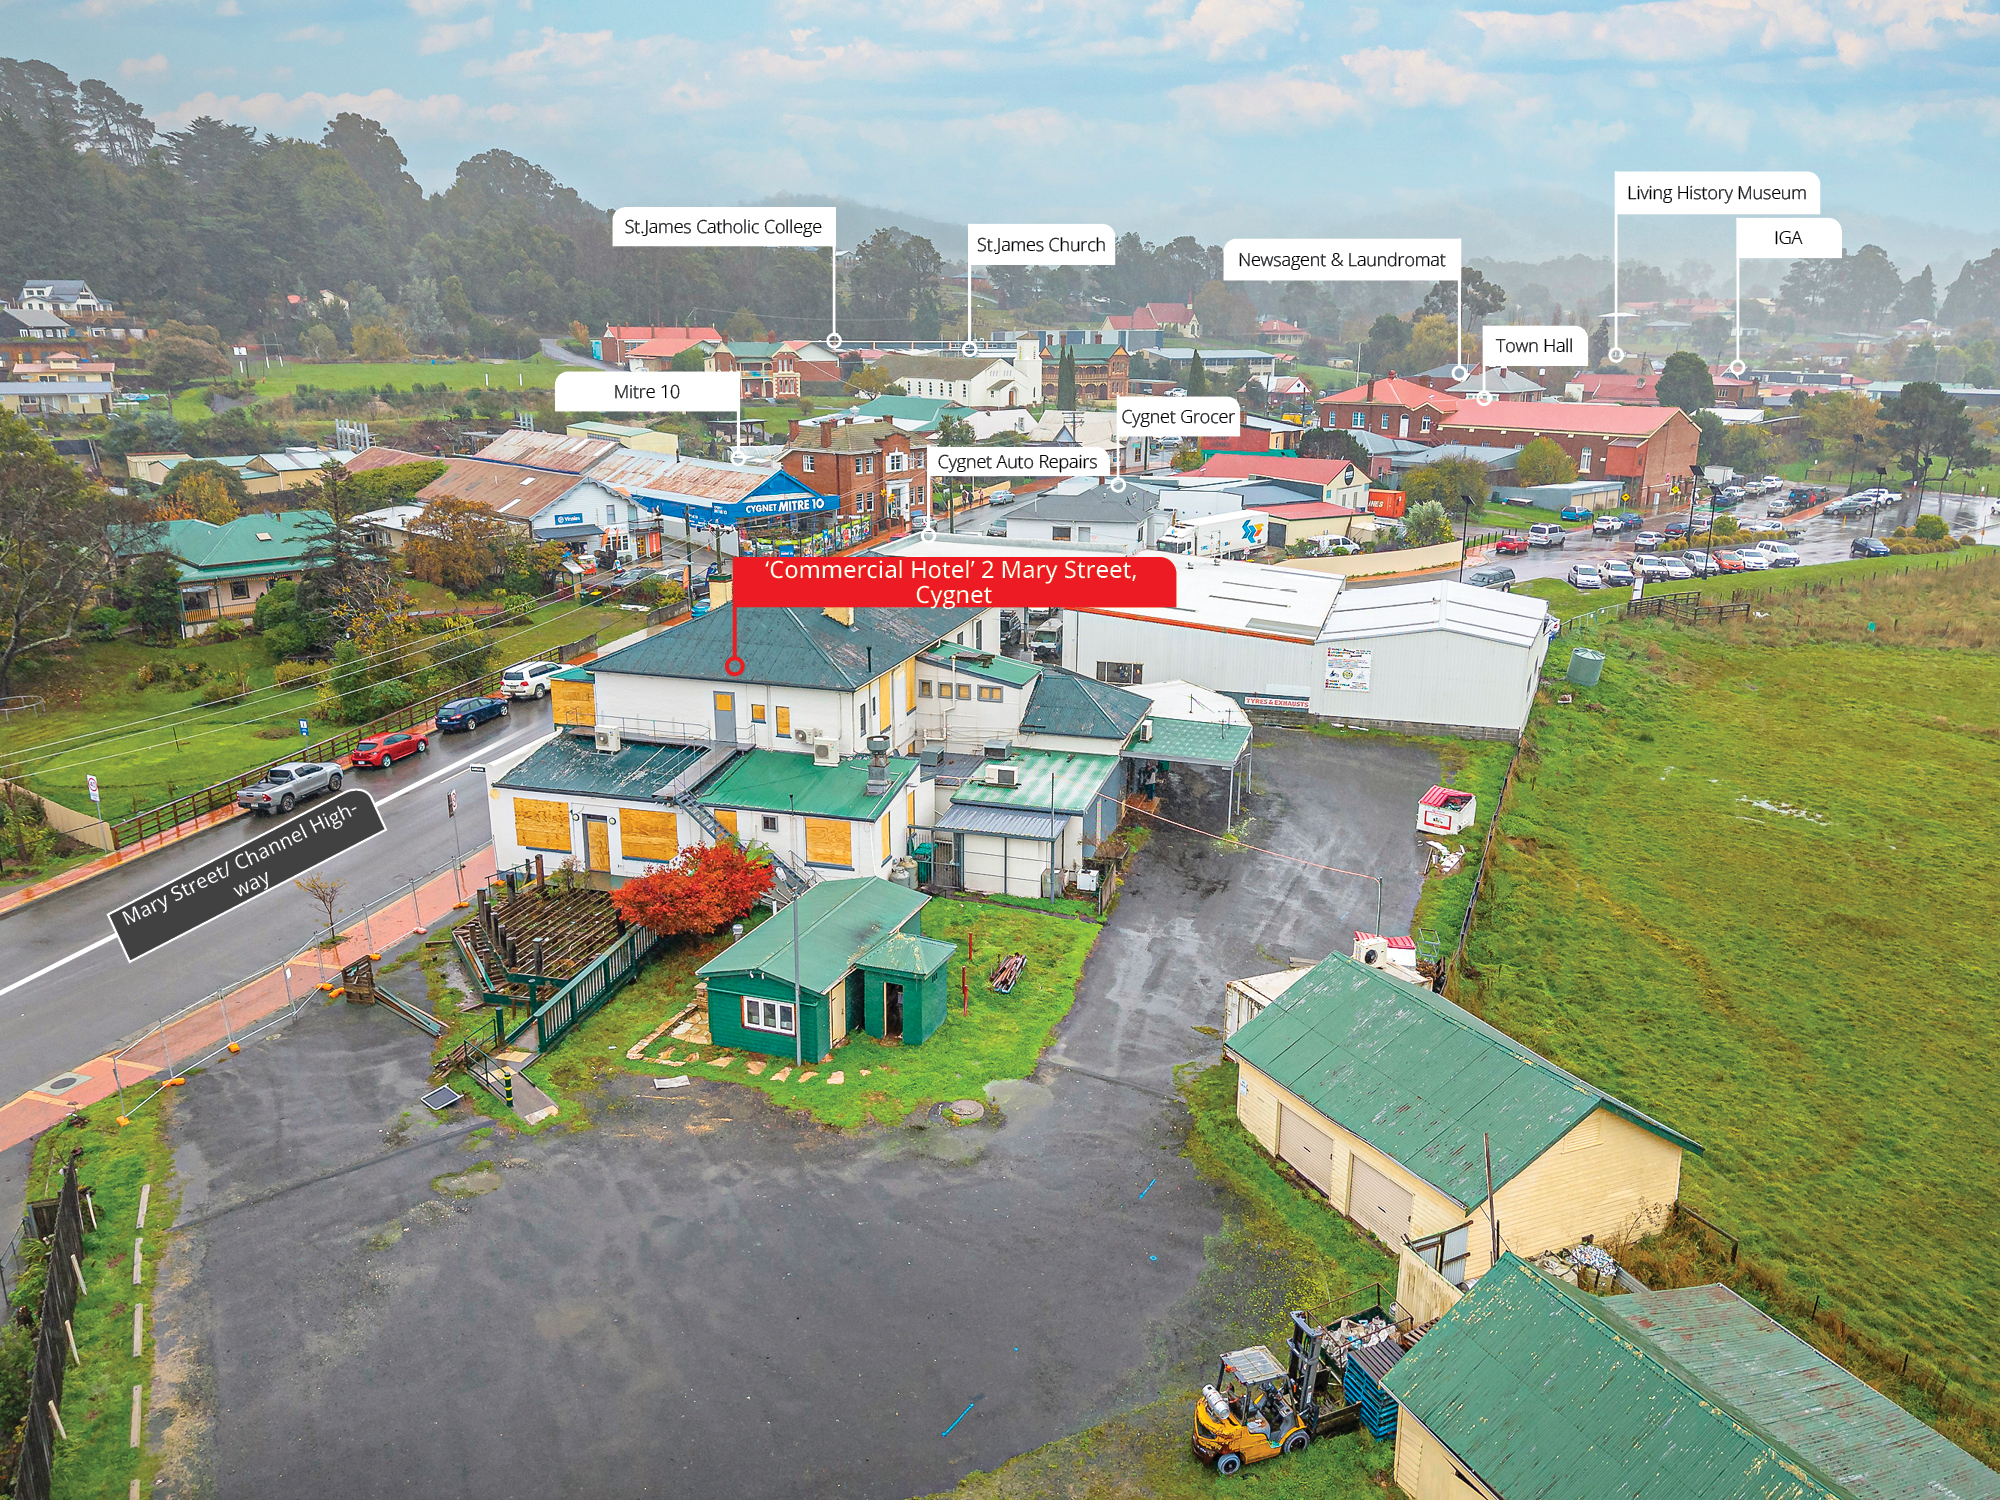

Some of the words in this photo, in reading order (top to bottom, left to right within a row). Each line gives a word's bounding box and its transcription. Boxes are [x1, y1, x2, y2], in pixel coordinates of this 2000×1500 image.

[746, 504, 777, 514] CYGNET
[778, 499, 810, 512] MITRE
[812, 498, 825, 509] 10
[1367, 500, 1384, 508] INES
